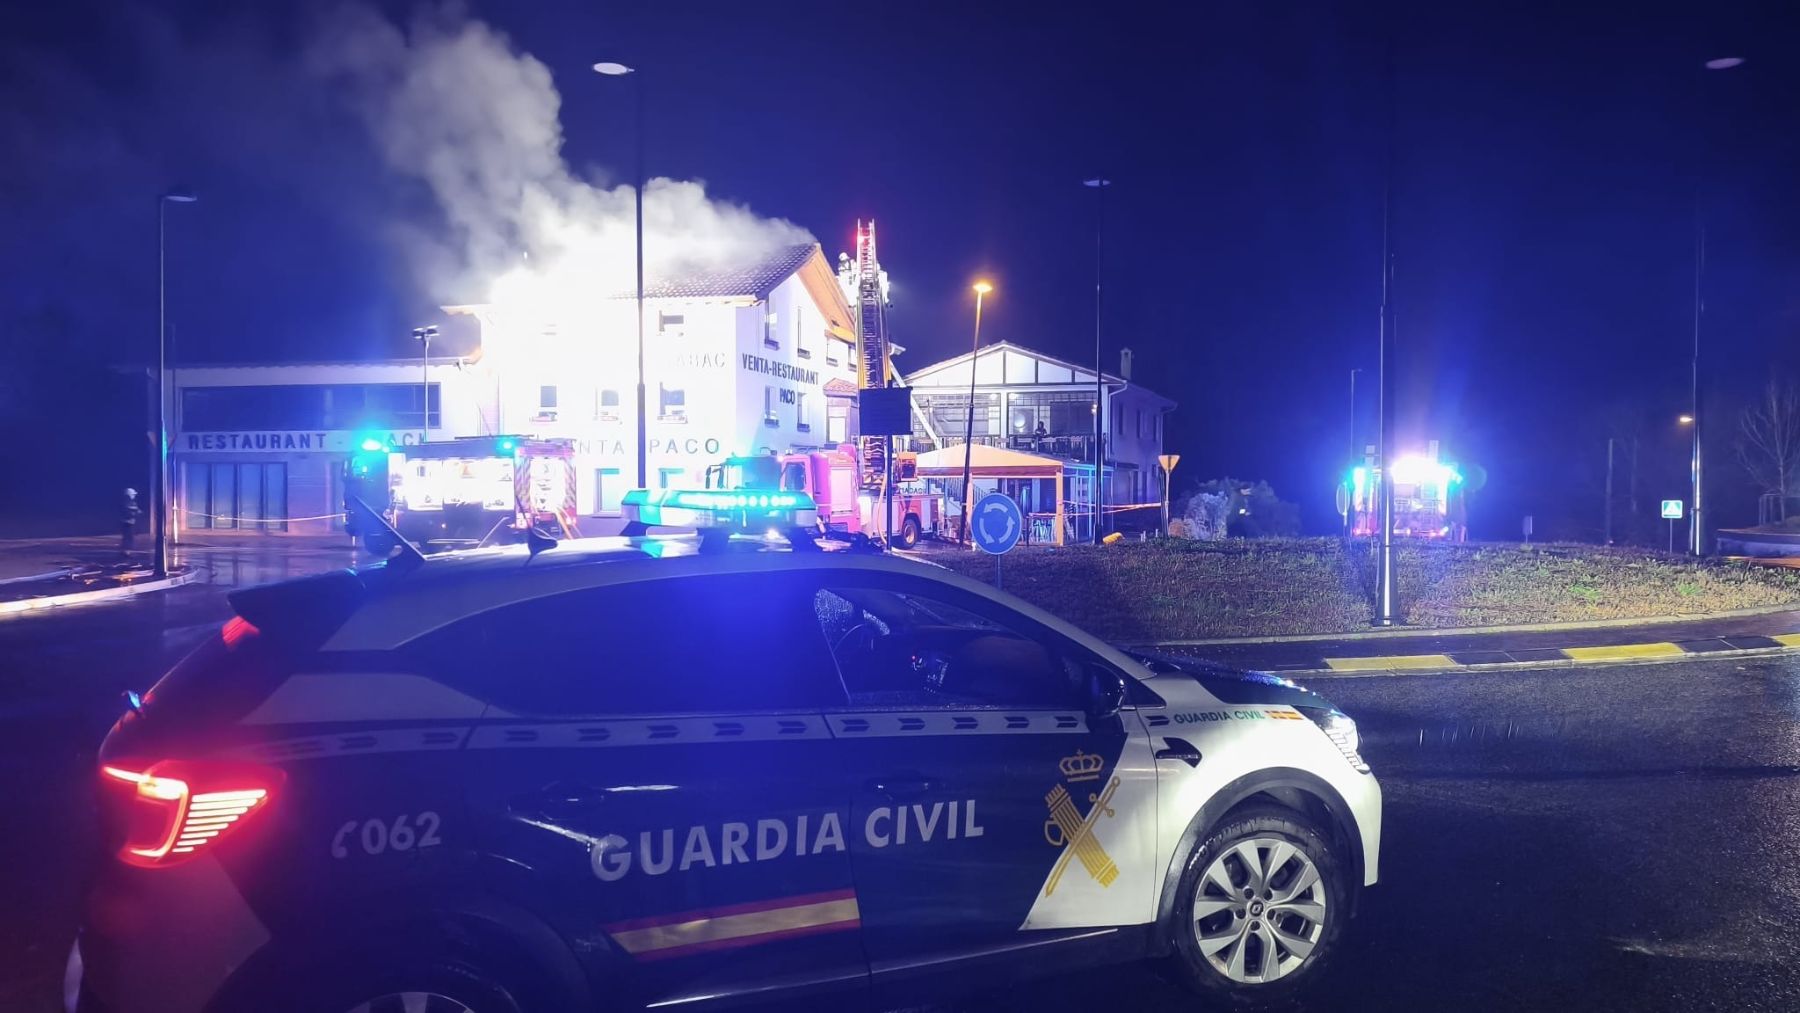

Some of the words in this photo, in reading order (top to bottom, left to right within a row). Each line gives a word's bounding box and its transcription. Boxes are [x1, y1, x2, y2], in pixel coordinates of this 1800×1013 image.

[742, 353, 819, 385] VENTA-RESTAURANT
[779, 387, 796, 405] PACO
[188, 433, 327, 450] RESTAURANT
[648, 438, 720, 455] PACO
[1174, 710, 1231, 724] GUARDIA
[1234, 709, 1265, 720] CIVIL
[361, 811, 442, 855] 062
[591, 812, 845, 882] GUARDIA
[864, 799, 984, 848] CIVIL
